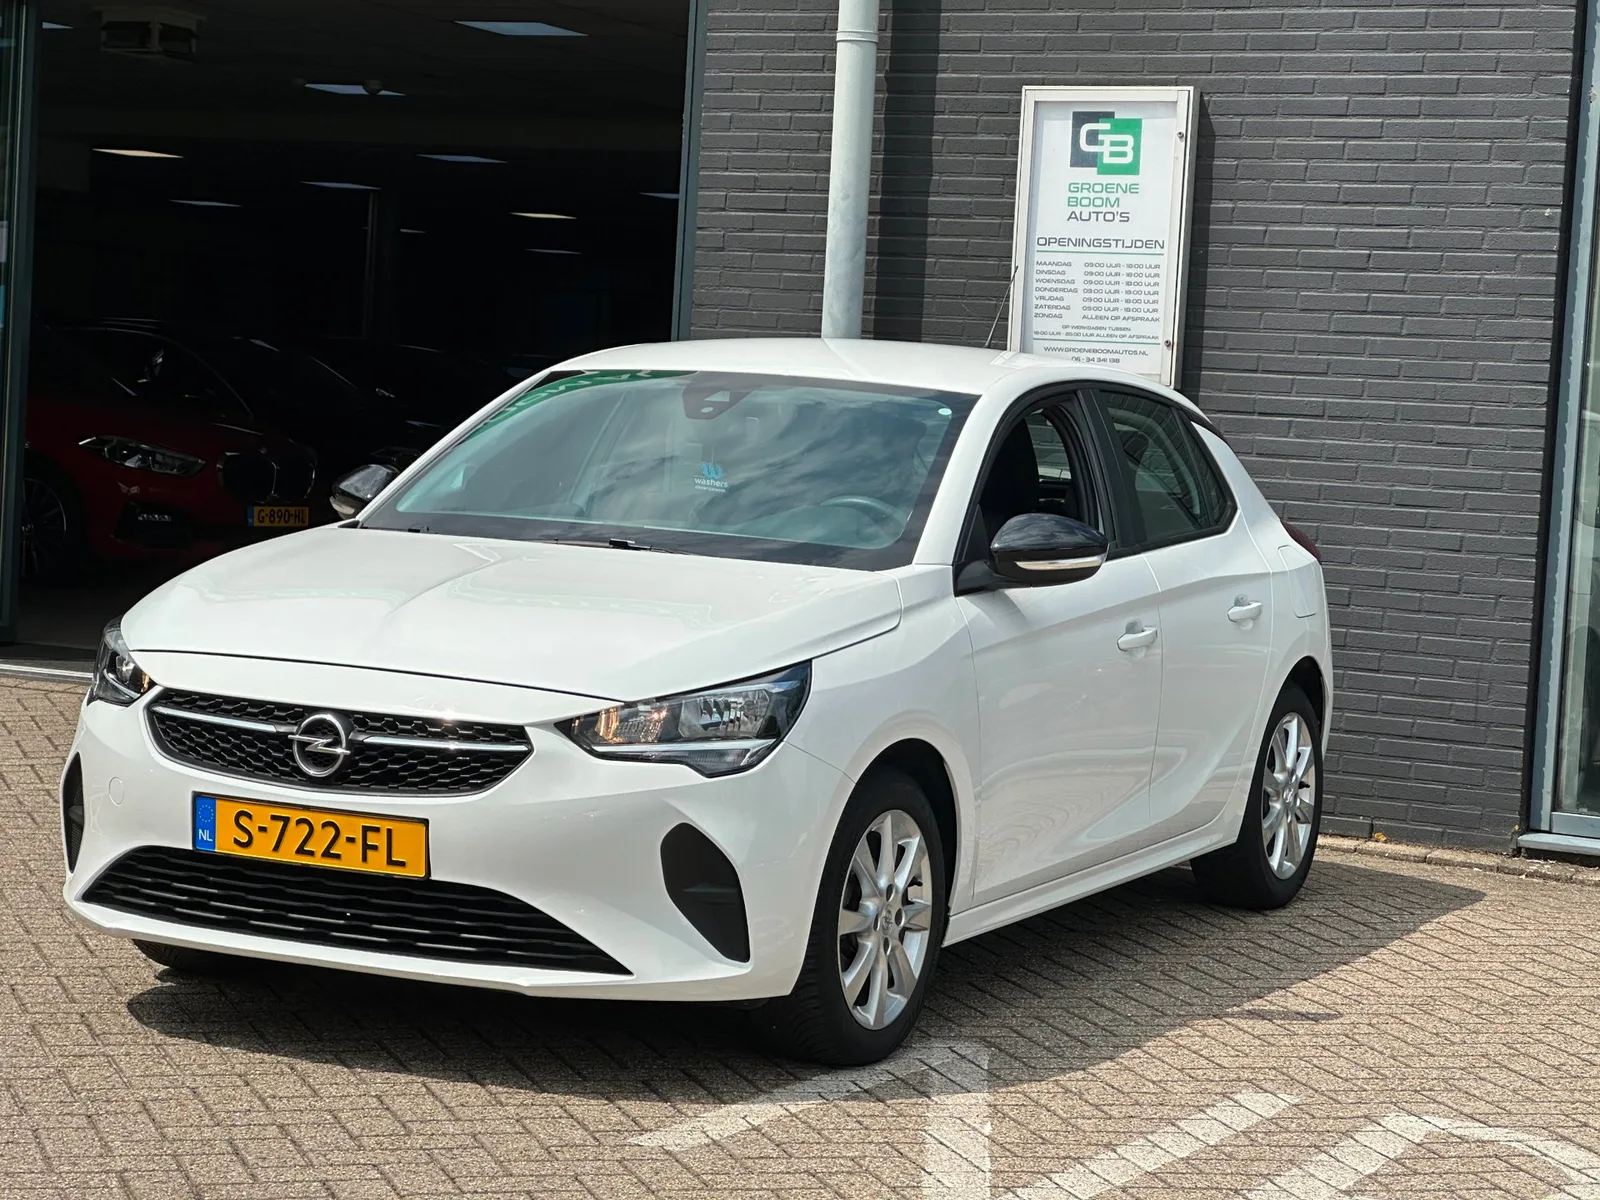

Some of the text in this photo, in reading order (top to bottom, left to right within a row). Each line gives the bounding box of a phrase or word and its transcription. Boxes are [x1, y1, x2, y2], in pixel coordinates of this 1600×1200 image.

[1068, 182, 1140, 195] GROENE
[1067, 196, 1121, 208] BOOM
[1066, 210, 1131, 223] AUTO'S
[1036, 236, 1165, 250] OPENINGSTIJDEN
[1036, 260, 1072, 268] MAANDAG
[1034, 286, 1079, 294] DONDERDAG
[1034, 303, 1071, 311] ZATERDAG
[1044, 346, 1148, 356] WWW.GROENEBOOMAUTOS.NL
[694, 478, 729, 488] washers
[257, 508, 306, 524] G-890-HL
[198, 828, 213, 842] NL
[233, 809, 406, 867] S-722-FL
